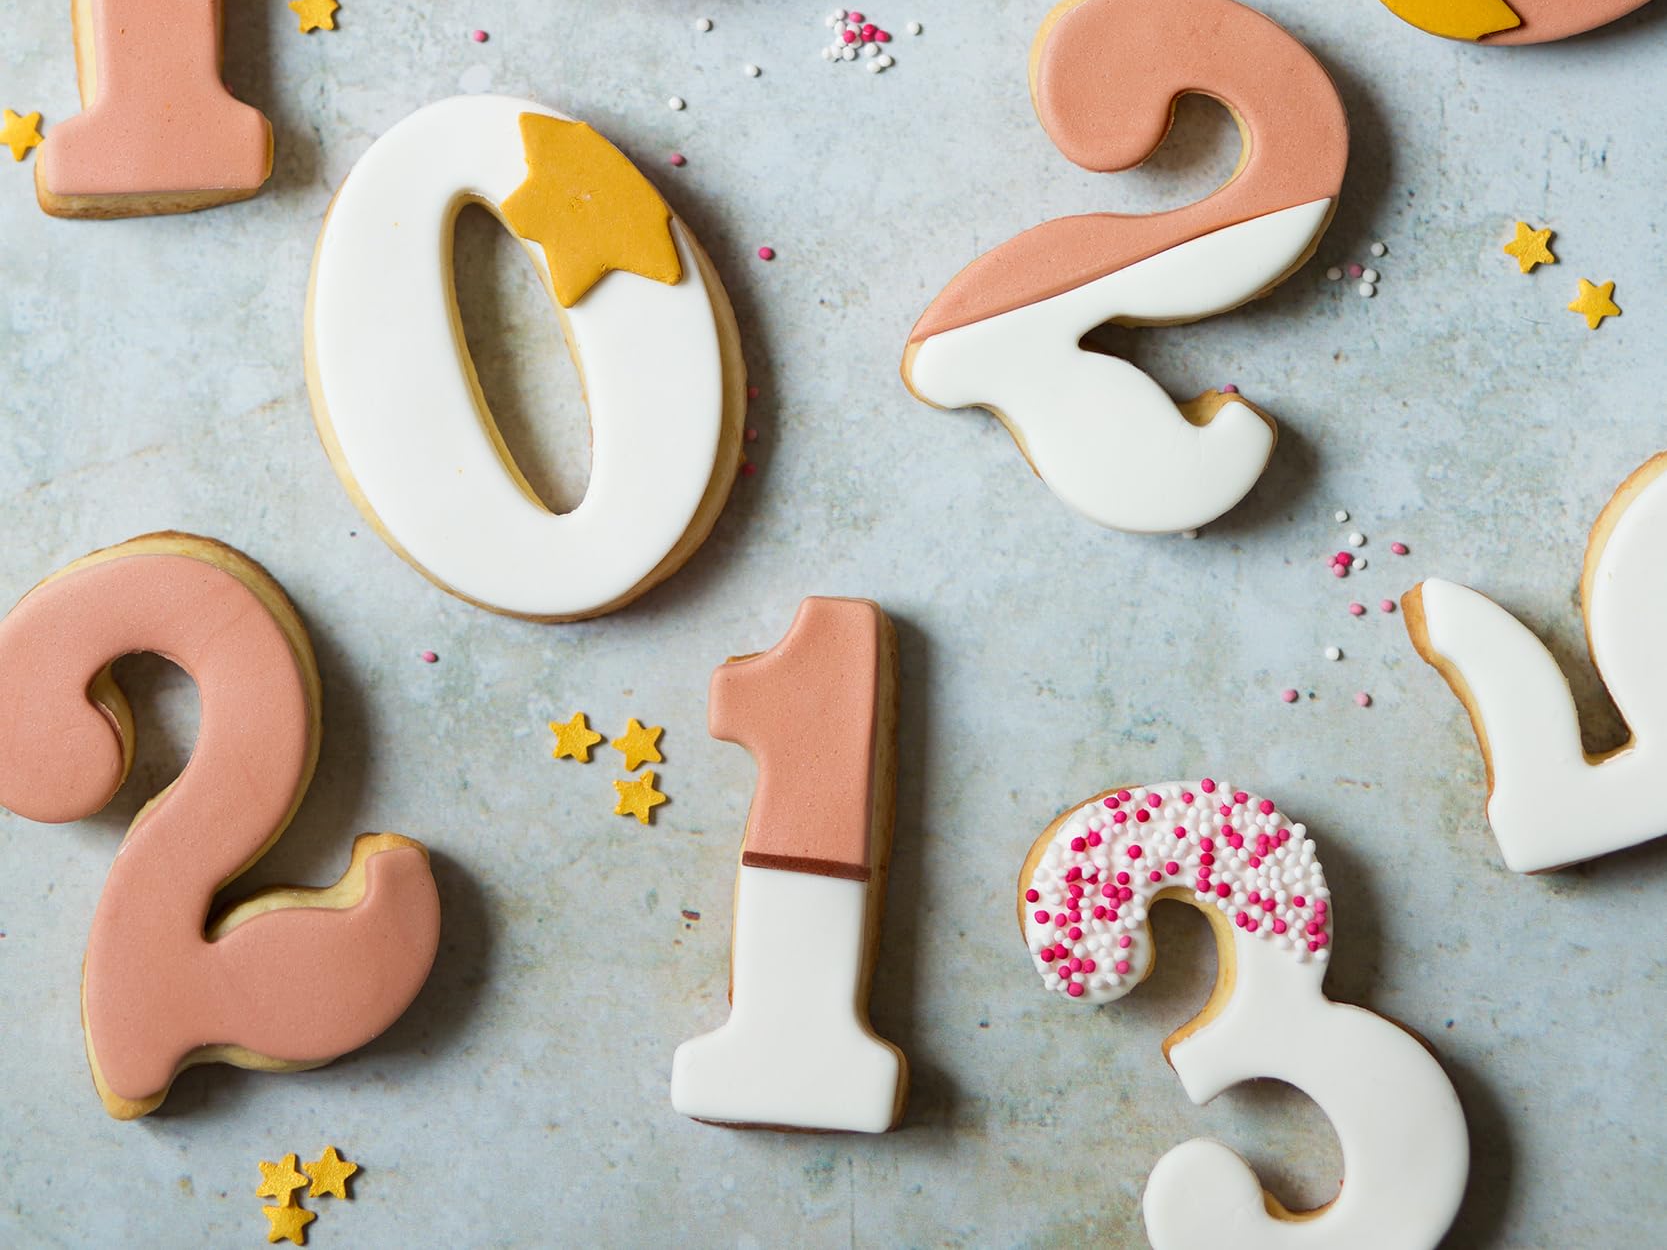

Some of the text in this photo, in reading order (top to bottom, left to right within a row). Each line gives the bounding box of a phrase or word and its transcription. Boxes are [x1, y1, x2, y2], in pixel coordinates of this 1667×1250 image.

[304, 93, 748, 624] 0
[0, 529, 442, 1122] 2
[671, 596, 910, 1134] 1
[1017, 779, 1471, 1250] 3
